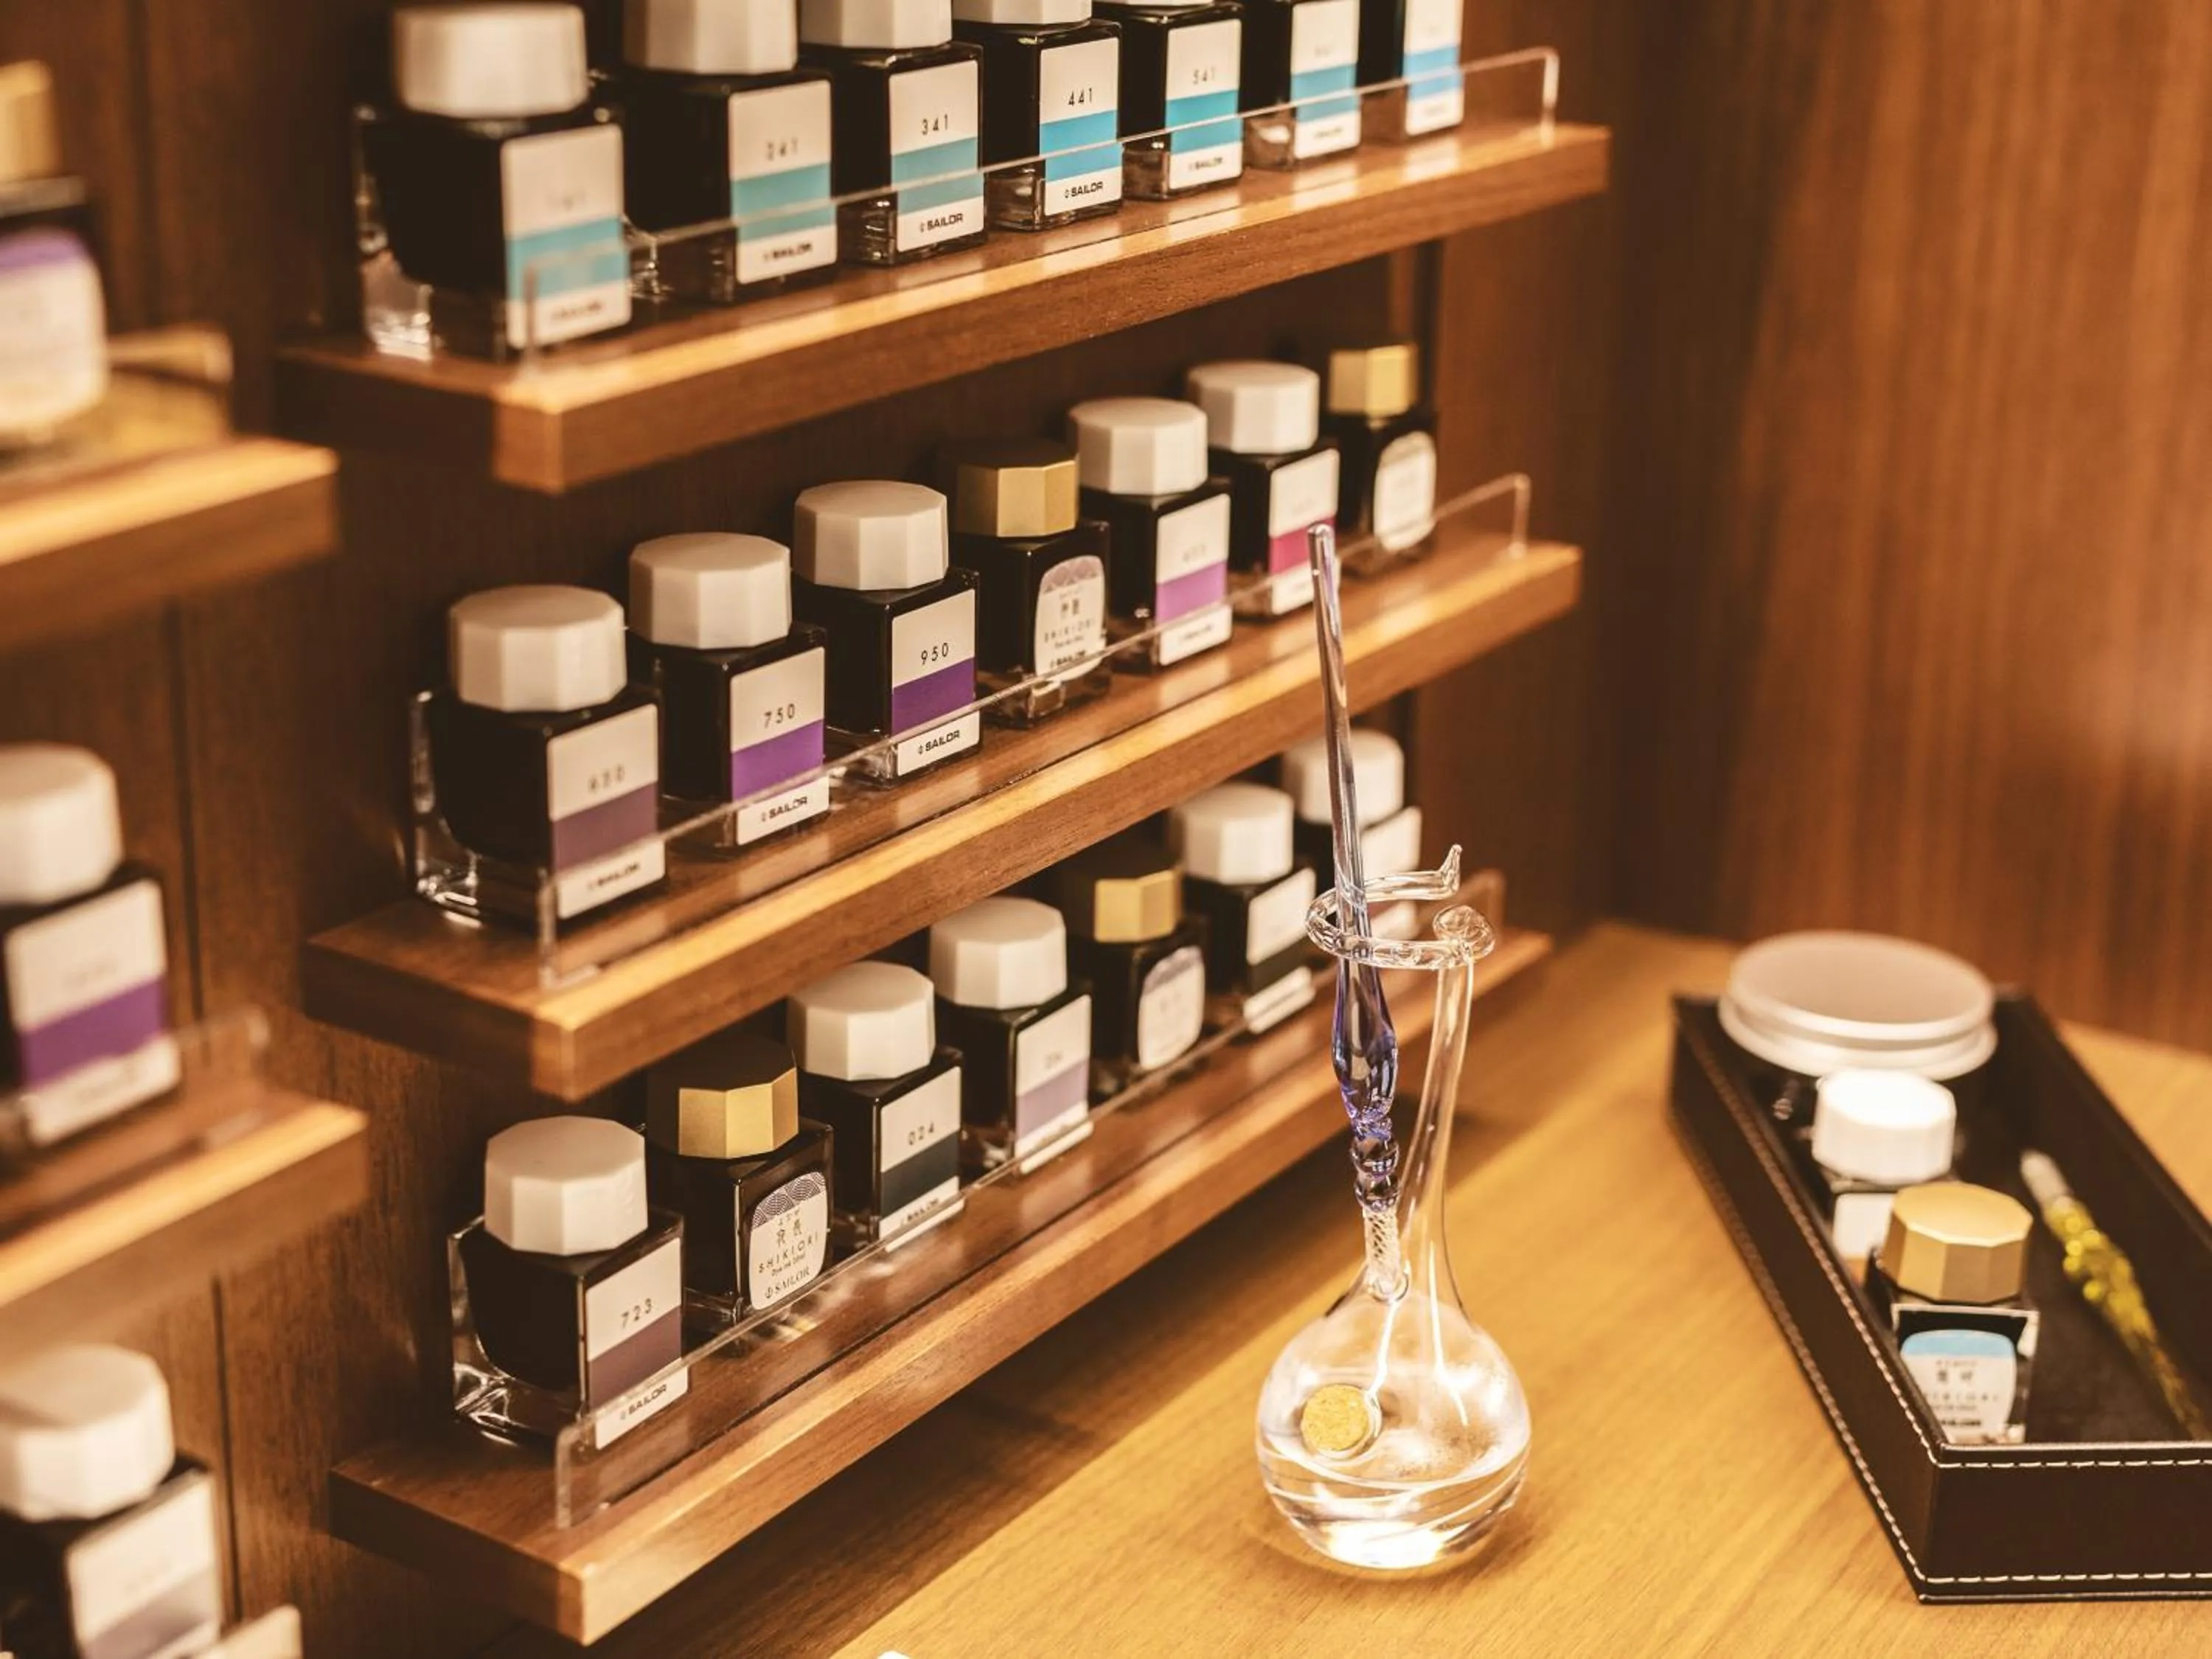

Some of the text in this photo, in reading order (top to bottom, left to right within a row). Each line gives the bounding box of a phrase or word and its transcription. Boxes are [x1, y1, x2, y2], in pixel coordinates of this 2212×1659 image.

[1068, 88, 1092, 106] 441
[922, 114, 948, 135] 341
[1071, 181, 1103, 197] SAILOR
[927, 213, 963, 231] SAILOR
[773, 243, 812, 259] SAILOR
[921, 642, 949, 665] 950
[764, 703, 795, 728] 750
[925, 729, 961, 751] SAILOR
[769, 796, 807, 818] SAILOR
[758, 1231, 818, 1273] SHIKIORI
[620, 1298, 653, 1329] 723
[628, 1384, 667, 1415] SAILOR
